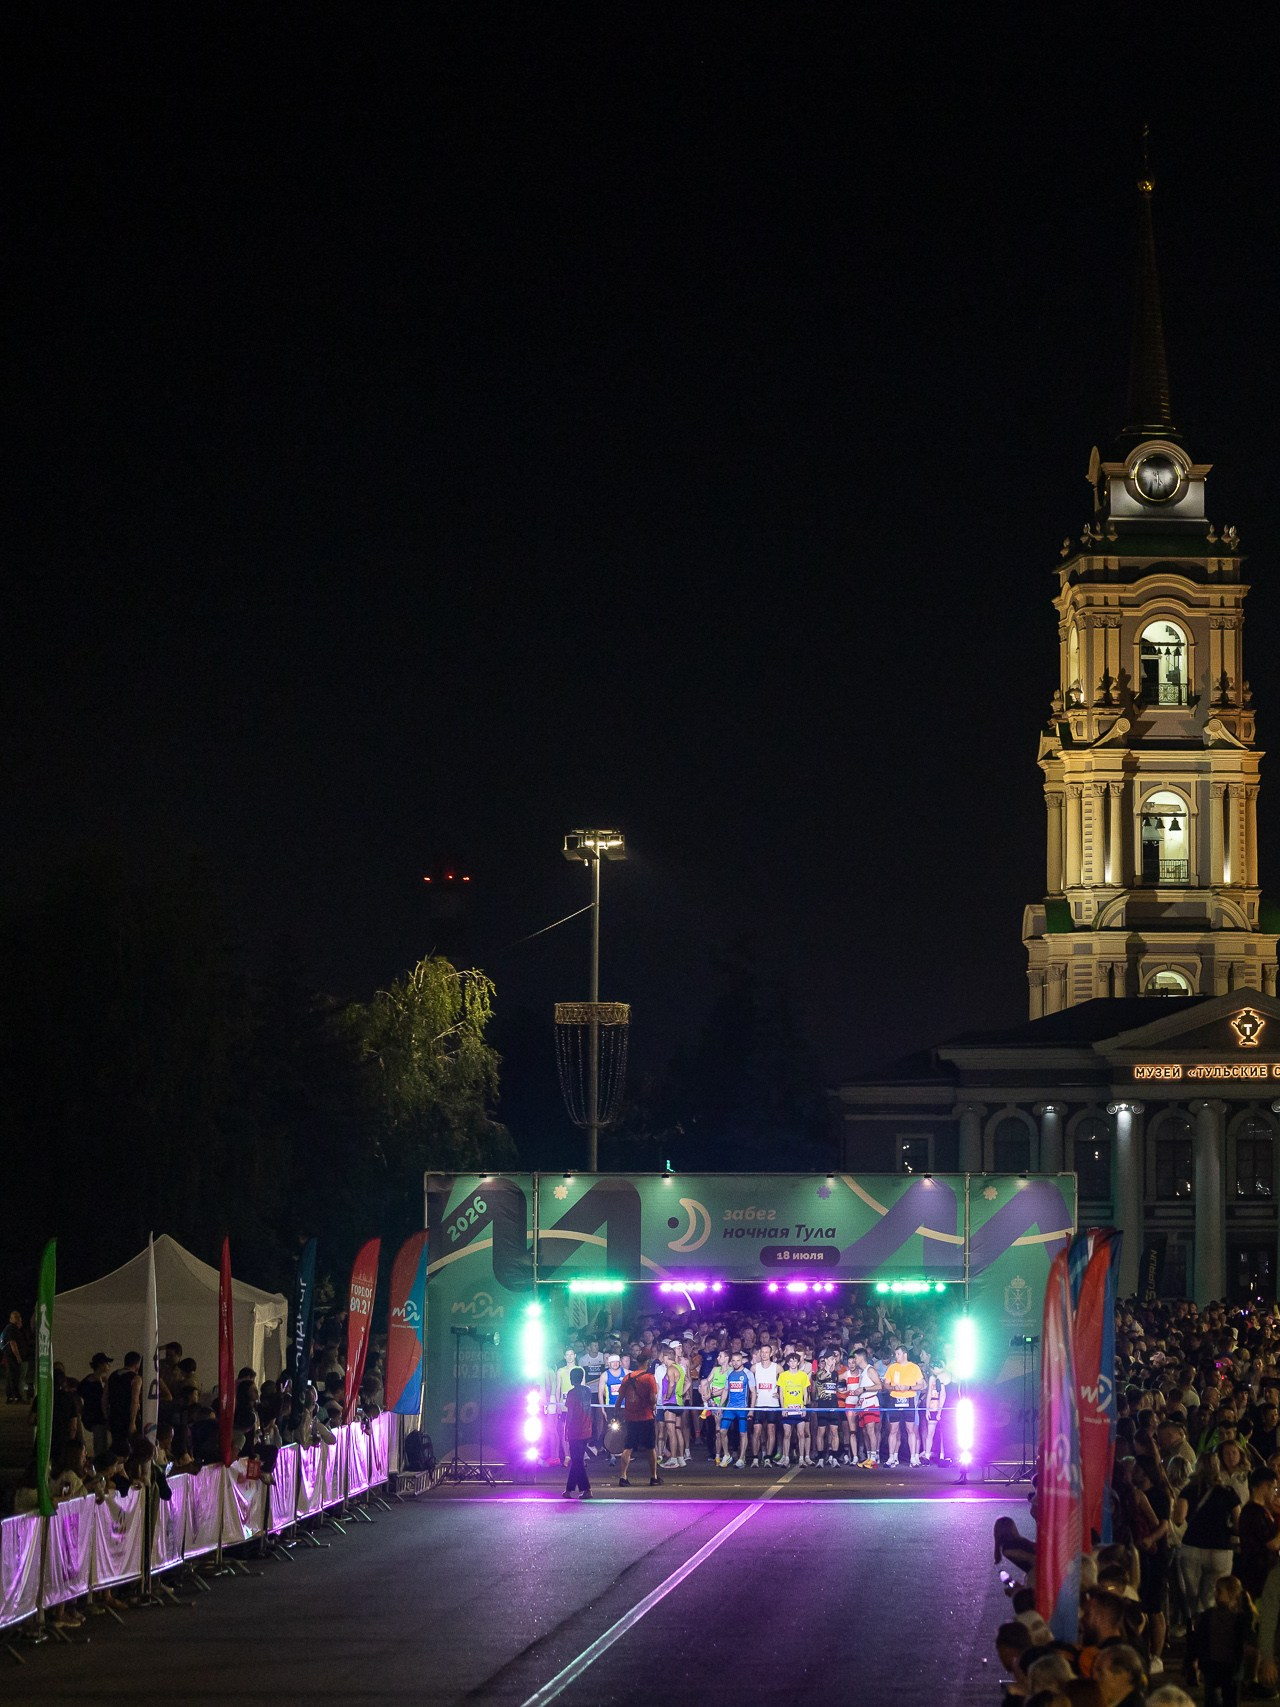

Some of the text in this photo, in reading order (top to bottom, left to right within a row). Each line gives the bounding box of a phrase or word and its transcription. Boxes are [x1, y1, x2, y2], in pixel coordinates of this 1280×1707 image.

[1135, 1064, 1182, 1078] МУЗЕЙ
[1188, 1065, 1267, 1078] «ТУЛЬСКИЕ
[446, 1196, 488, 1242] 2026
[723, 1206, 777, 1221] забег
[723, 1224, 836, 1242] ночная Тула
[776, 1250, 824, 1260] 18 июля
[441, 1401, 479, 1424] 10
